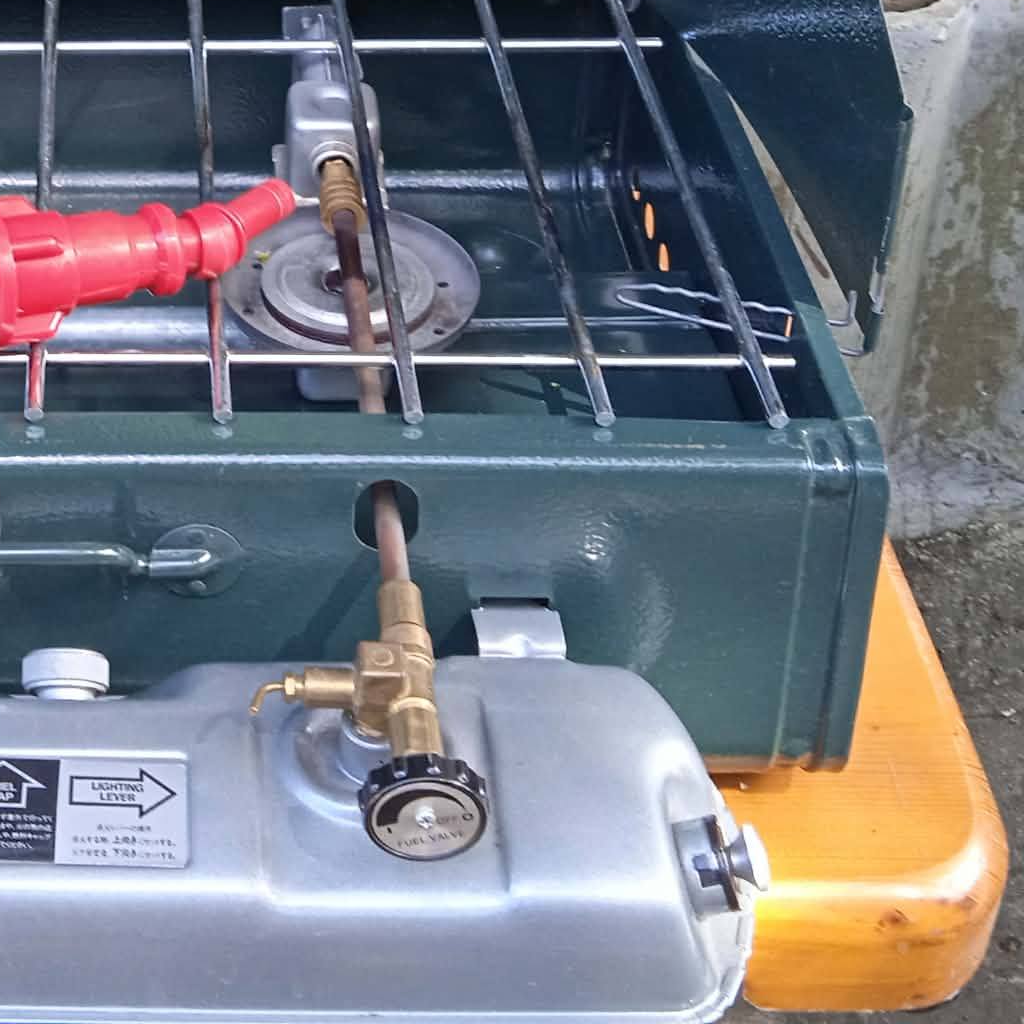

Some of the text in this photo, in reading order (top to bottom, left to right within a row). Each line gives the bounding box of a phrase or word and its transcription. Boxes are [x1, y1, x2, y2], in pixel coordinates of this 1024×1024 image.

[91, 781, 145, 792] LIGHTING
[99, 792, 136, 802] LEVER
[428, 830, 464, 843] VALVE
